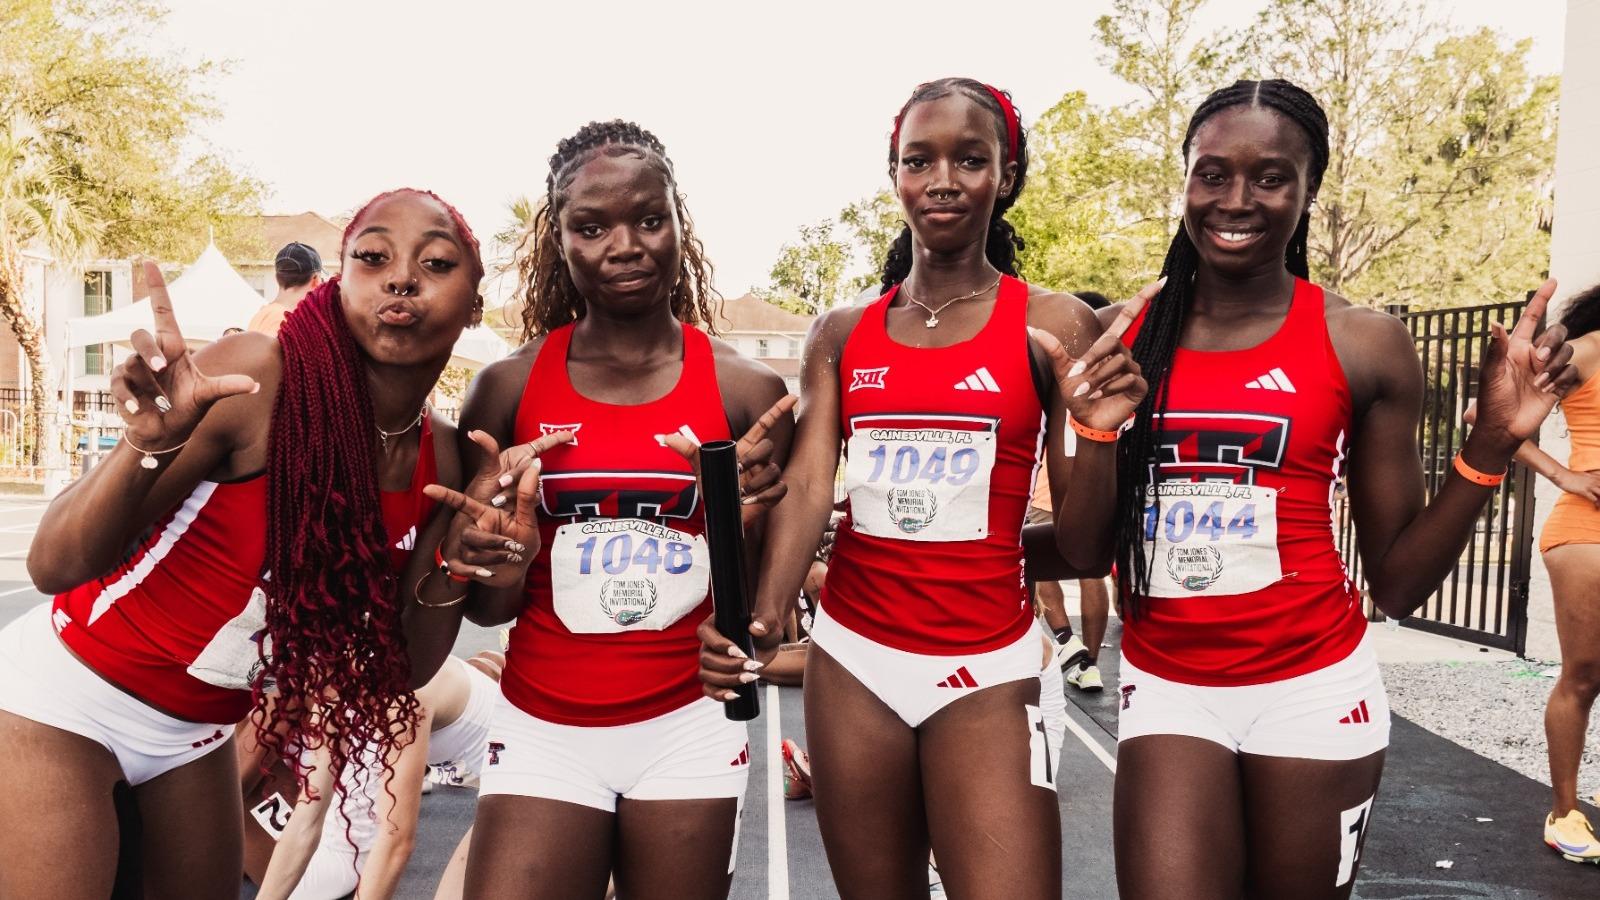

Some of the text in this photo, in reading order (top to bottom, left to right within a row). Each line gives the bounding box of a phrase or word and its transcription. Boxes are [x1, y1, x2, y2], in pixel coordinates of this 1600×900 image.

[870, 430, 972, 444] GAINESVILLE, FL
[867, 444, 980, 486] 1049
[1233, 487, 1252, 499] FL
[897, 497, 924, 506] MEMORIAL
[1143, 500, 1258, 543] 1044
[582, 520, 682, 541] GAINESVILLE, FL
[576, 534, 693, 575] 1048
[1176, 547, 1208, 556] TOM JONES
[1178, 555, 1208, 563] MEMORIAL
[1175, 563, 1213, 572] INVITATIONAL
[612, 580, 645, 589] TOM JONES
[613, 589, 643, 597] MEMORIAL
[609, 597, 647, 606] INVITATIONAL
